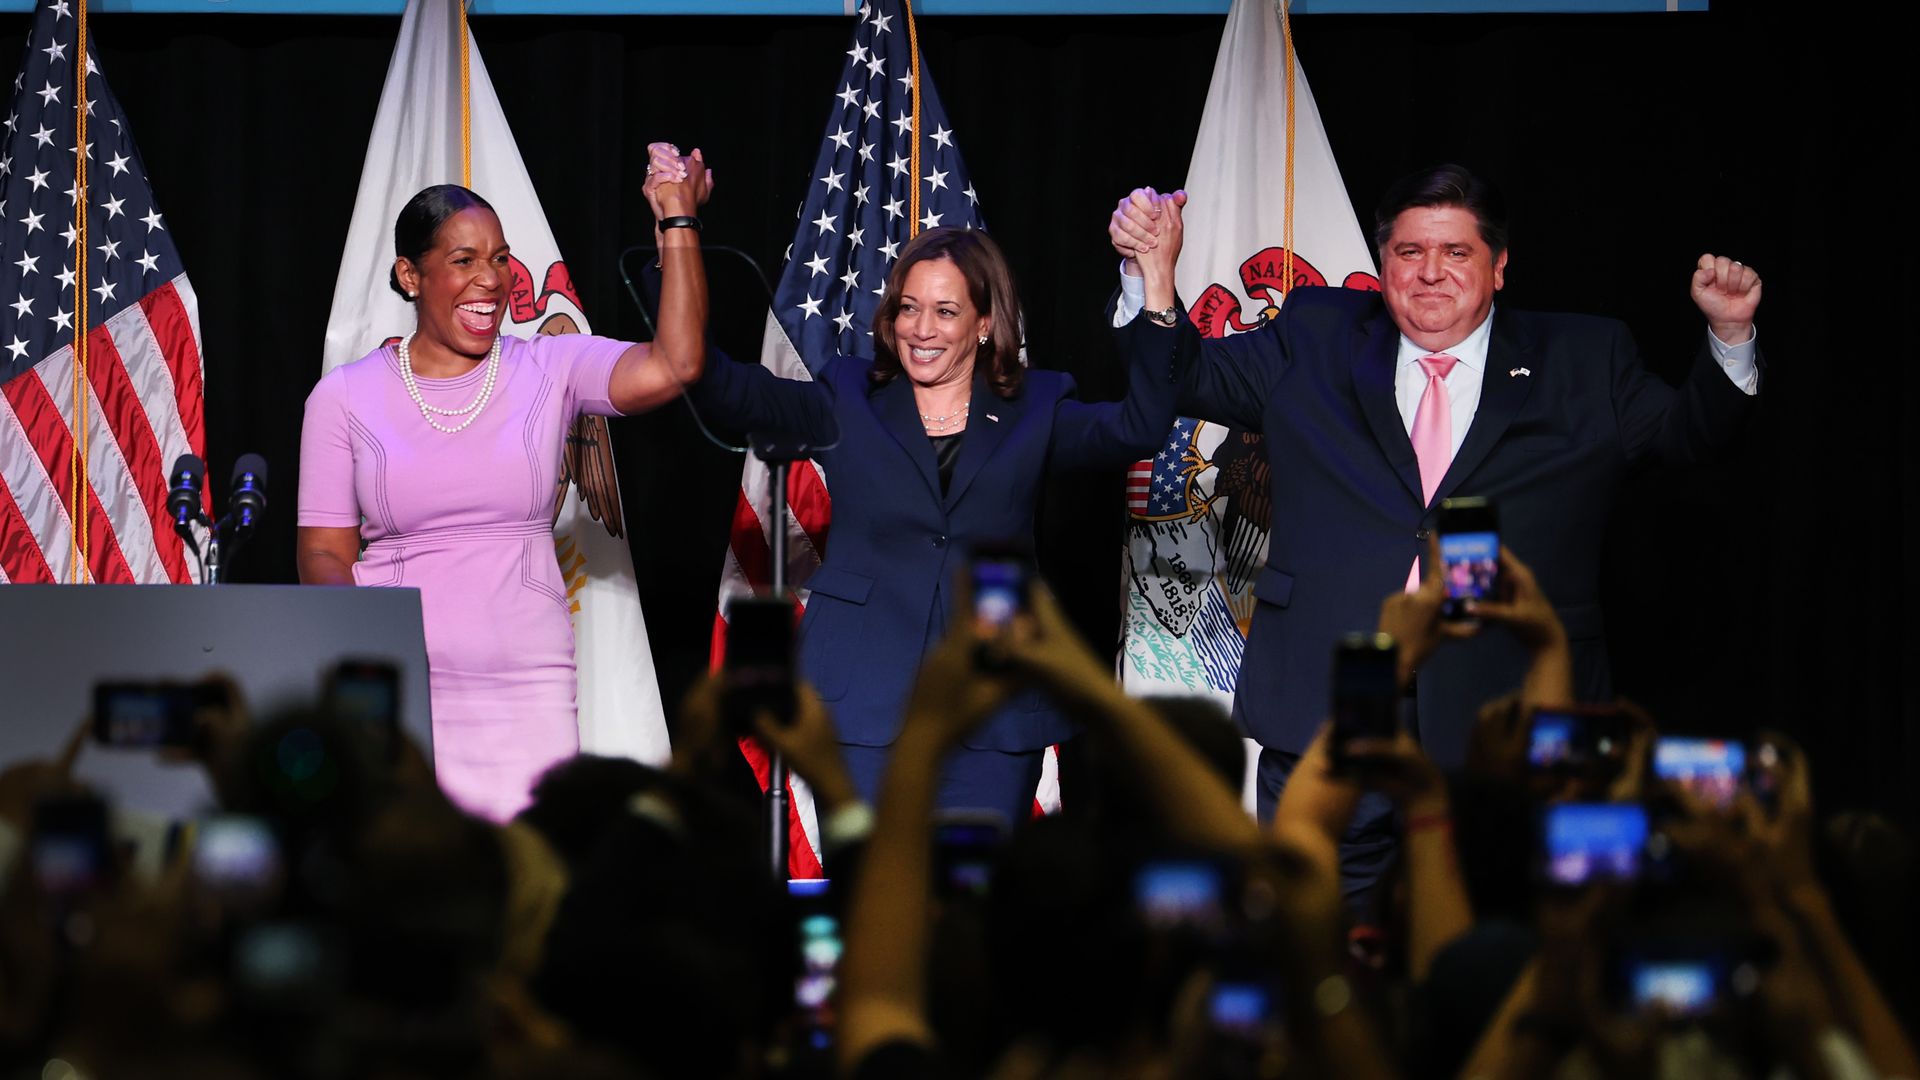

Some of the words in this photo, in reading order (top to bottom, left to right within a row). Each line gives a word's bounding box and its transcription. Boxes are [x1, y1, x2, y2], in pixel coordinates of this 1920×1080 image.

[1249, 261, 1315, 287] NATO
[1198, 290, 1224, 337] GNTY
[1167, 552, 1197, 595] 1868
[1159, 577, 1188, 617] 1818
